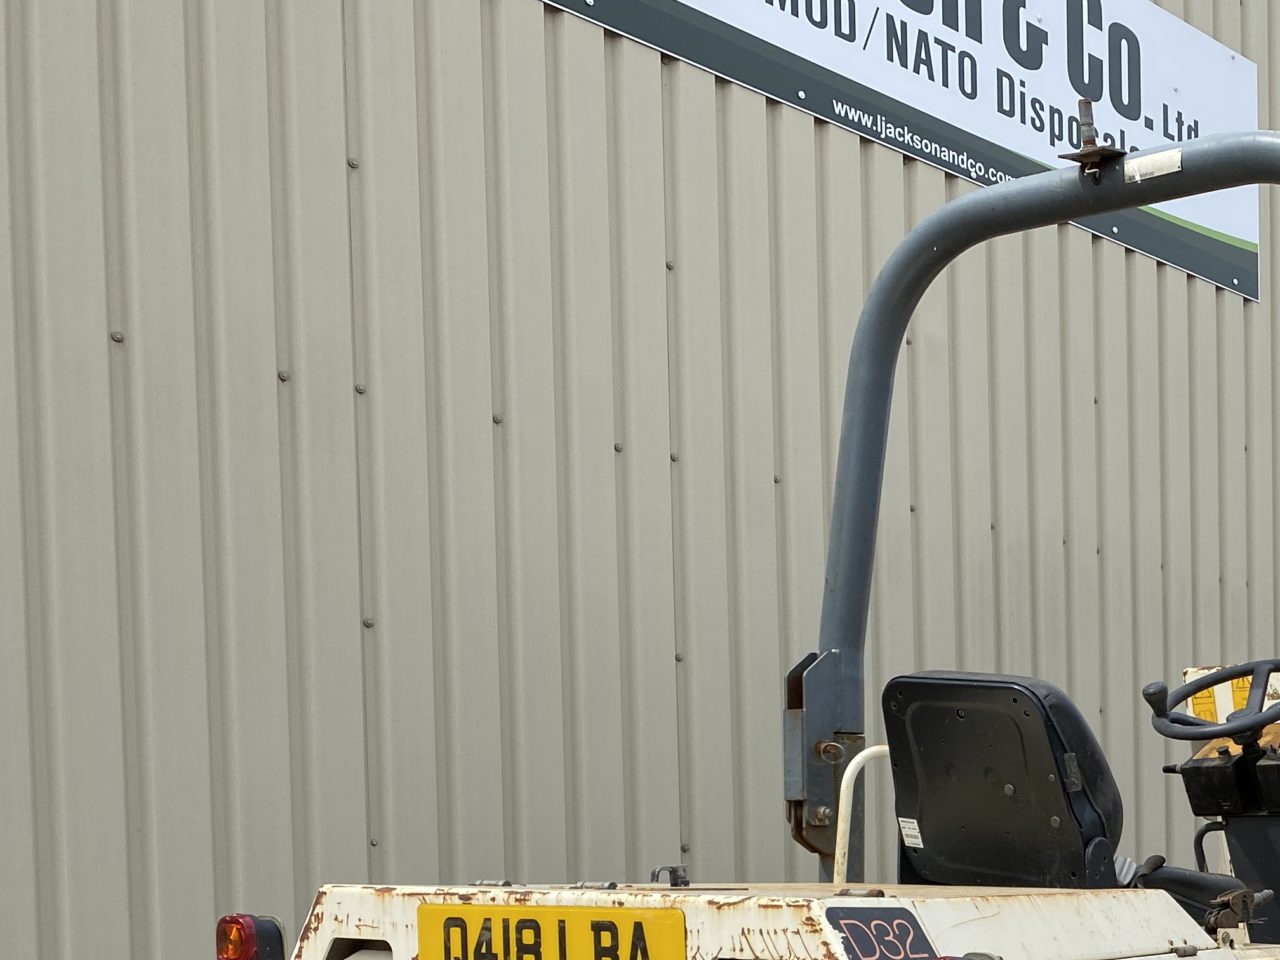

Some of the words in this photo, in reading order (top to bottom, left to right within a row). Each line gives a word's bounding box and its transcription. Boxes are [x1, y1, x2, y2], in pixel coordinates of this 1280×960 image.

[764, 0, 978, 101] OD/NATO
[996, 68, 1140, 152] Dispo
[1066, 0, 1154, 131] Co.
[838, 918, 929, 960] D32
